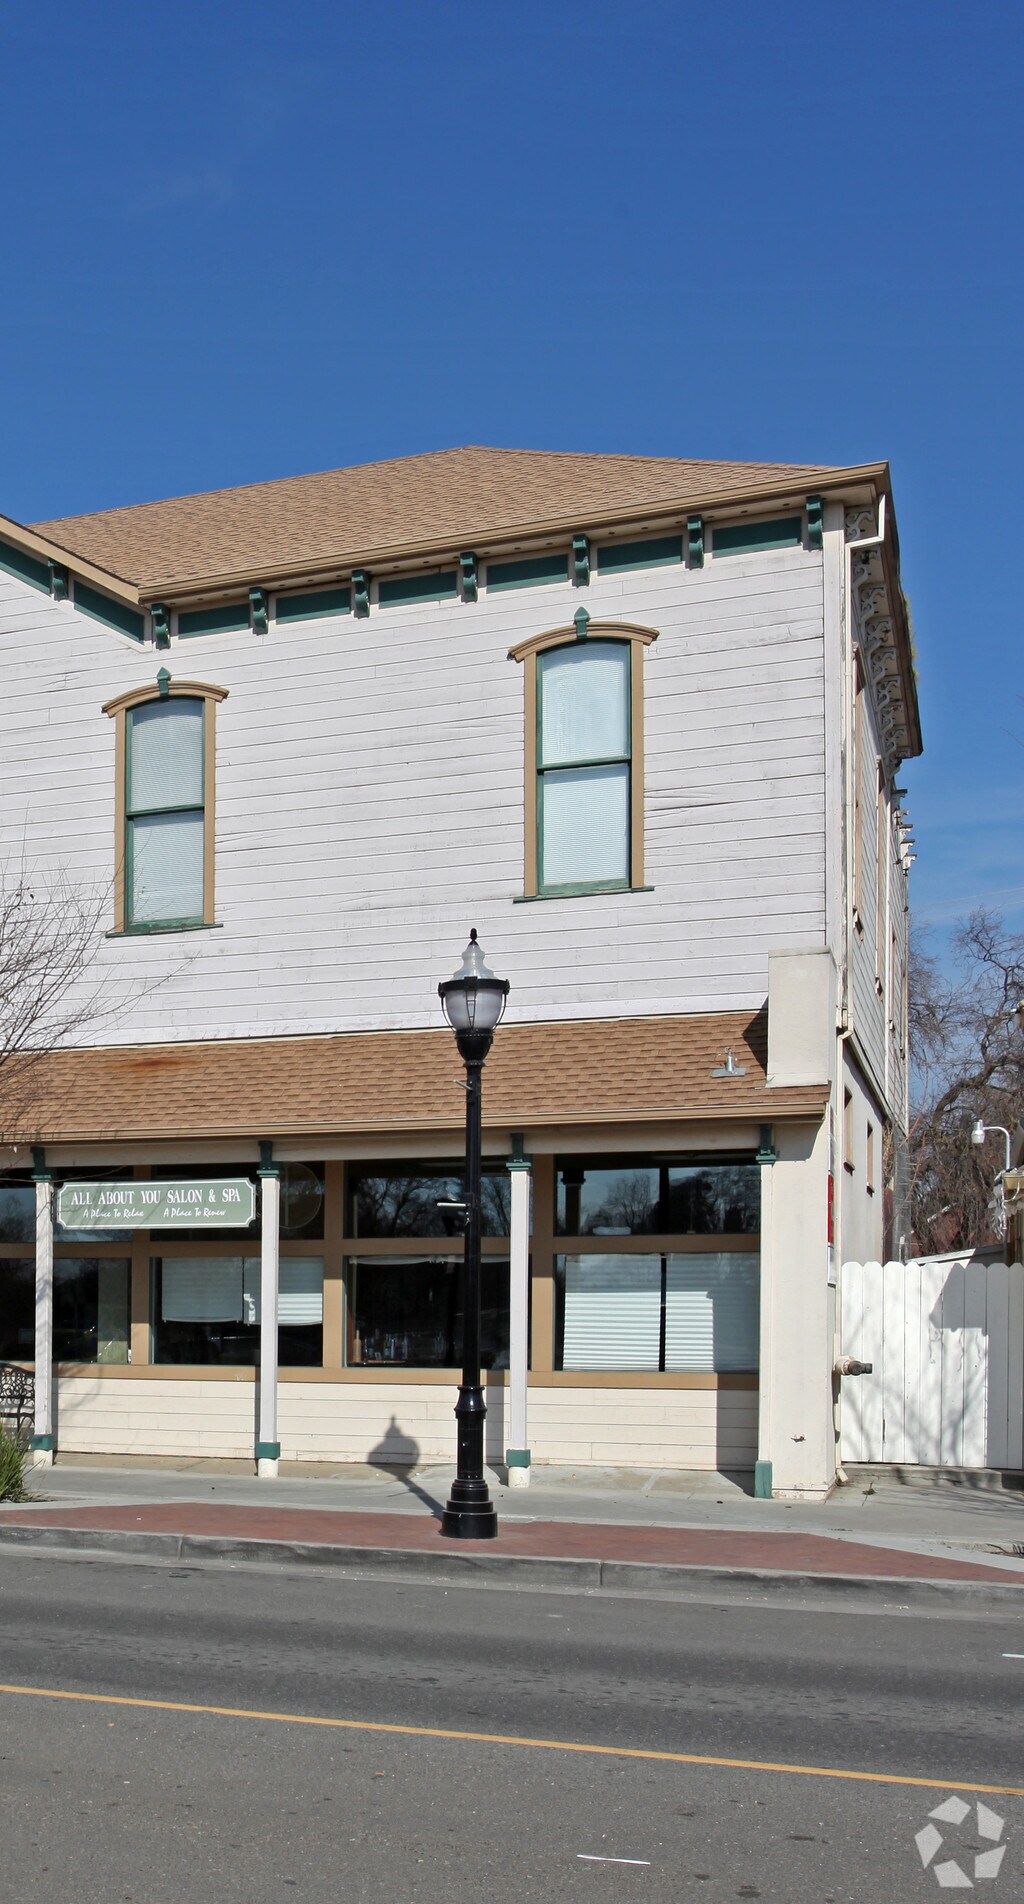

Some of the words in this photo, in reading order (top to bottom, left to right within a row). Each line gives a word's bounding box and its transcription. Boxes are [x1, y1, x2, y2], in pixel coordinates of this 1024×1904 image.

[71, 1191, 93, 1206] ALL
[98, 1190, 135, 1205] ABOUT
[140, 1190, 161, 1204] YOU
[167, 1189, 203, 1204] SALON
[208, 1188, 216, 1203] &
[222, 1188, 241, 1202] SPA
[82, 1209, 89, 1218] A
[90, 1208, 112, 1219] Place
[113, 1208, 122, 1218] To
[123, 1207, 145, 1219] Relax
[163, 1207, 170, 1218] A
[170, 1207, 193, 1218] Place
[194, 1207, 202, 1217] To
[203, 1207, 227, 1218] Renew
